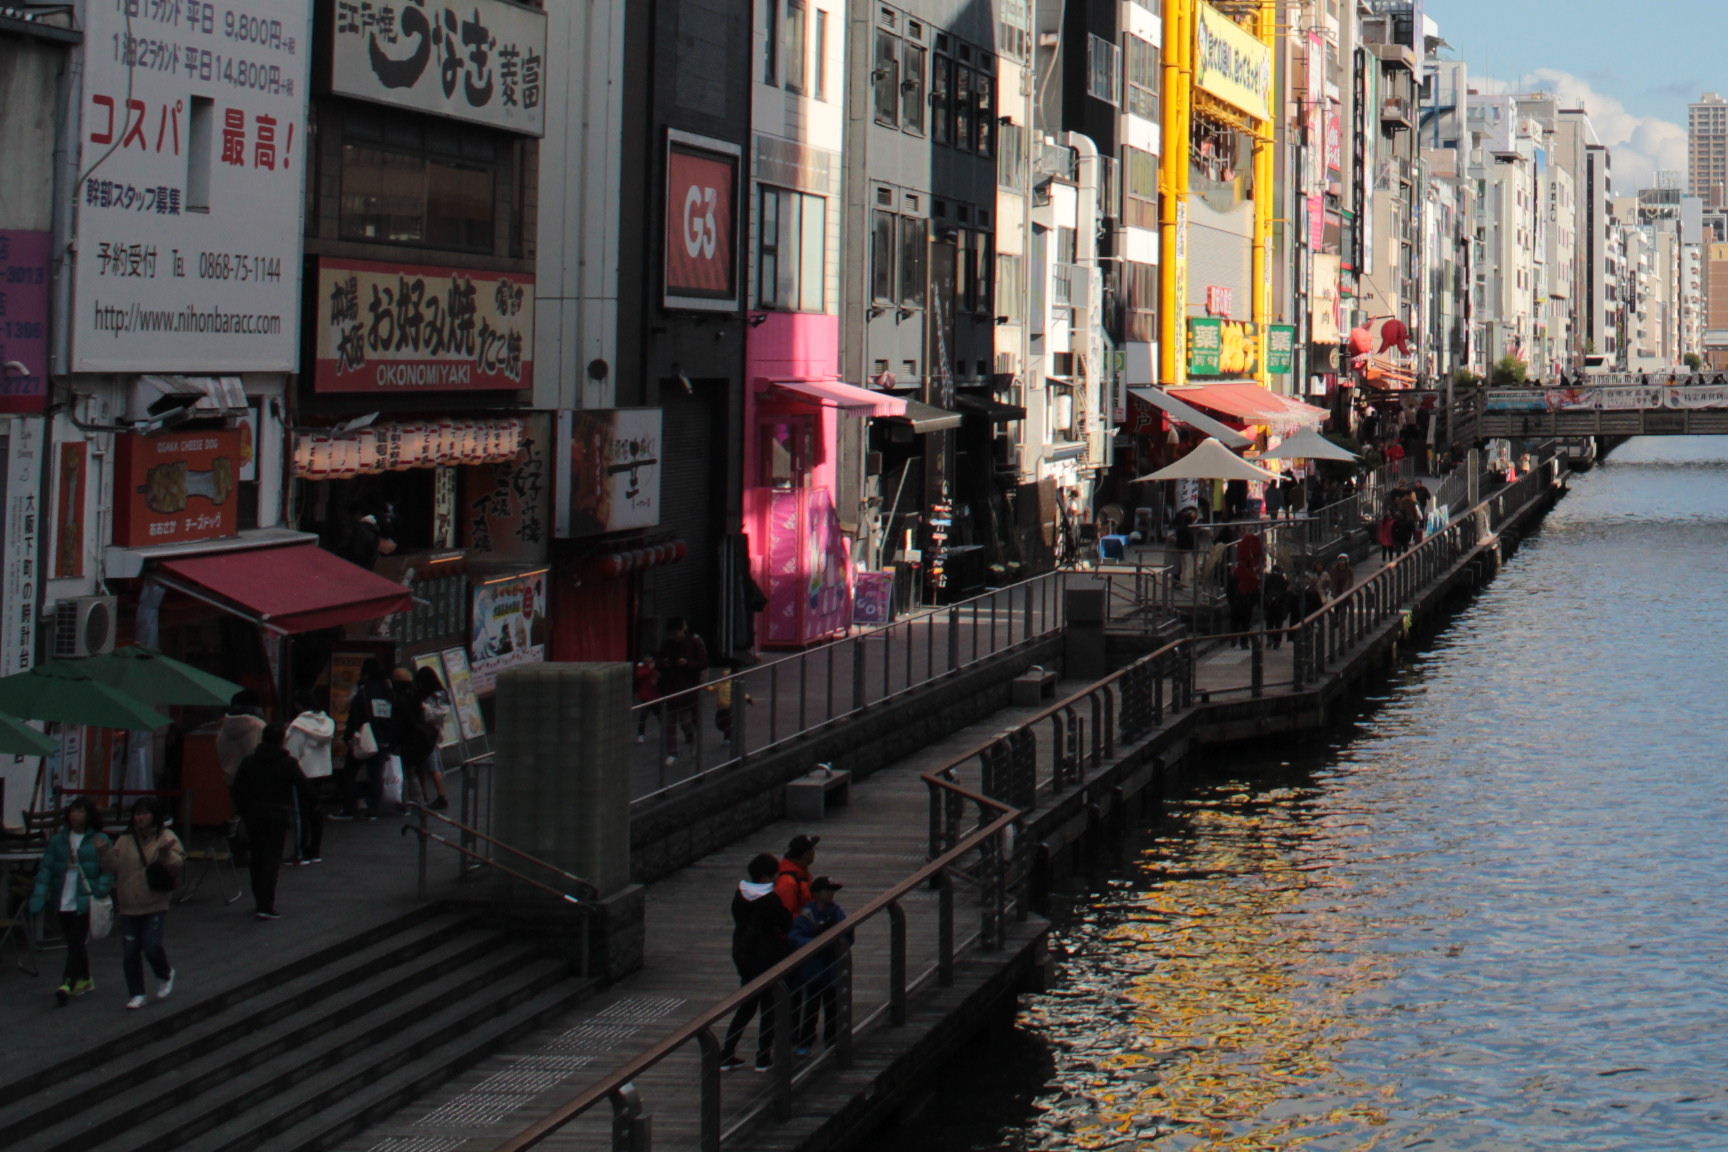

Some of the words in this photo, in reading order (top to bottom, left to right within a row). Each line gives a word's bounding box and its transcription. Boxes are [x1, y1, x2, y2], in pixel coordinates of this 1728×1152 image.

[90, 94, 183, 156] コスパ
[221, 107, 294, 171] 最高!
[86, 178, 181, 216] 幹部スタッフ募集
[683, 184, 717, 261] G3
[97, 242, 157, 279] 予約受付
[200, 251, 281, 283] 0868-75-1144
[94, 299, 281, 338] http://www.nihonbaracc.com
[367, 274, 477, 357] お好み焼
[376, 364, 471, 386] OKONOMIYAKI
[204, 439, 218, 450] DOG
